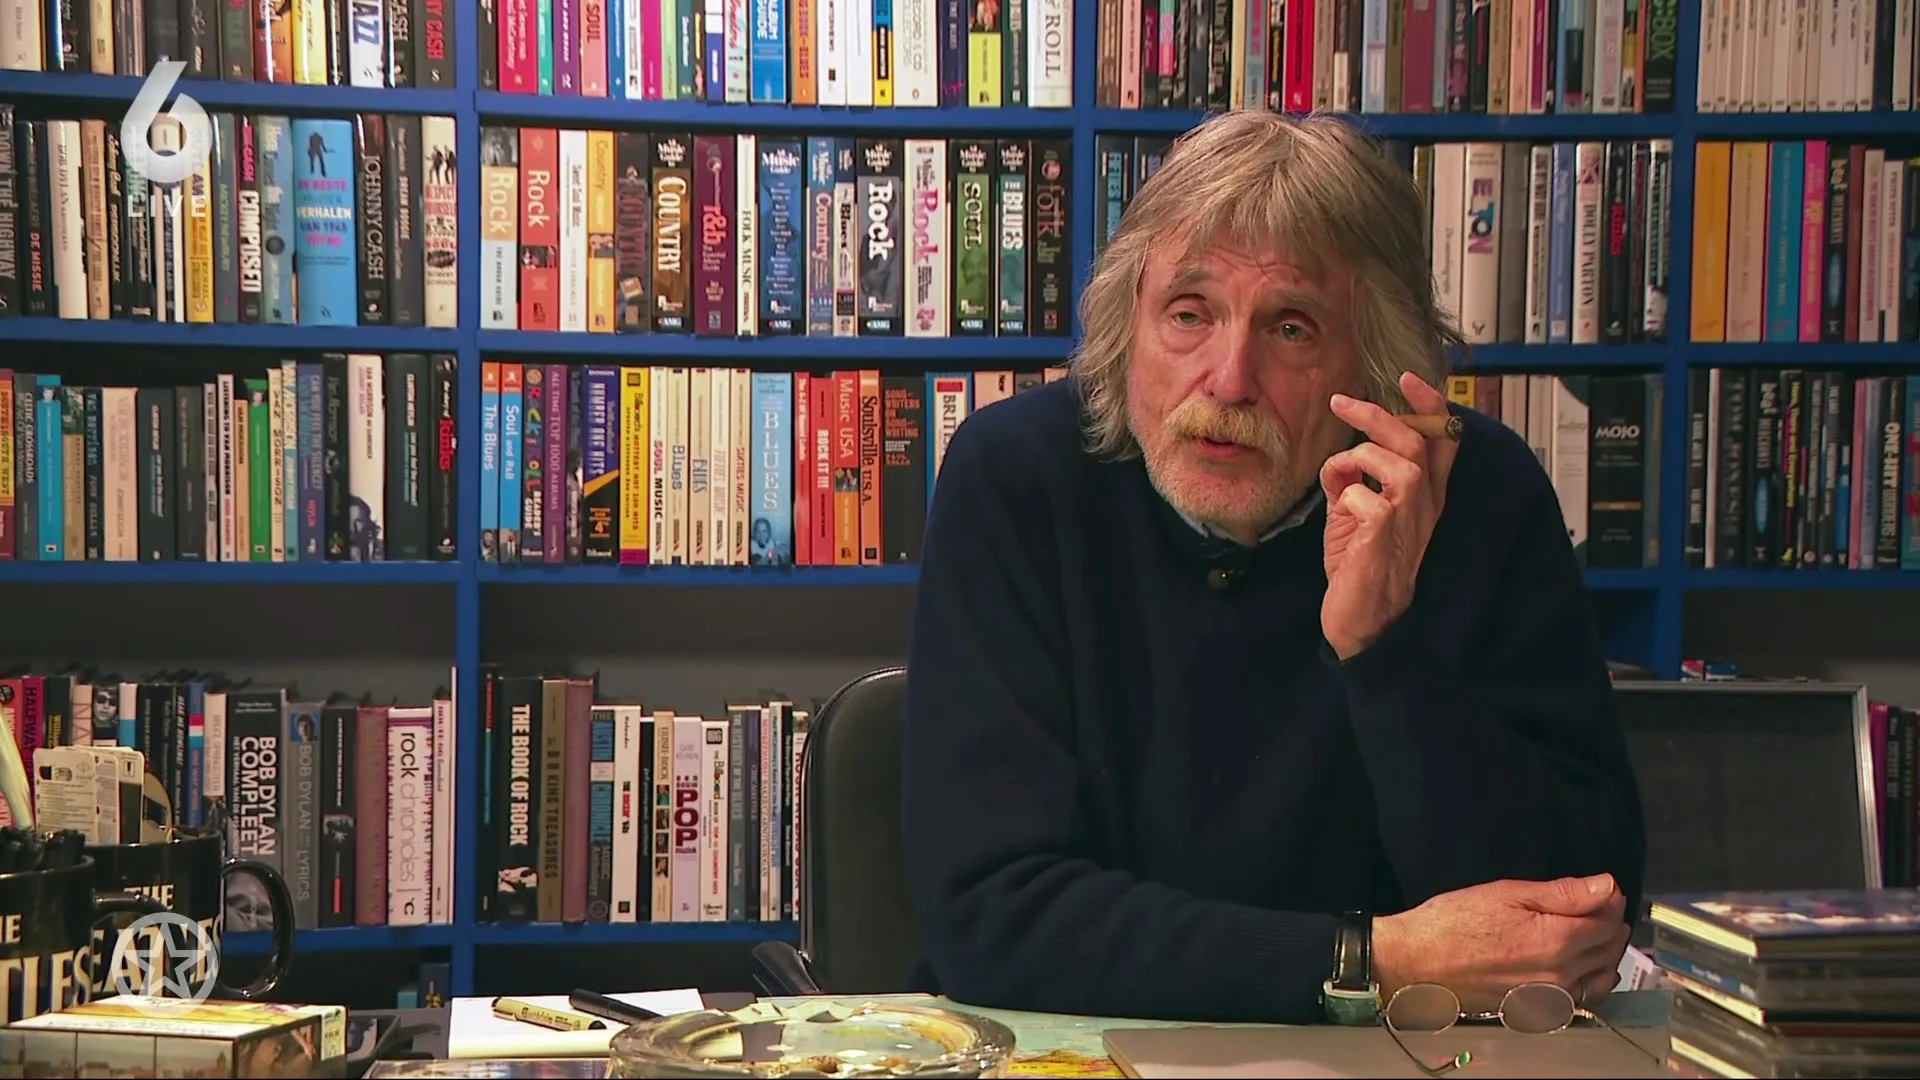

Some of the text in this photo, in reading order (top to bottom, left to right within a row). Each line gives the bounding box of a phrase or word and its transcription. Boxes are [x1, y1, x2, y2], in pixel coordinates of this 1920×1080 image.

[353, 0, 380, 45] AZZ
[425, 20, 444, 60] CASH
[586, 4, 601, 43] SOUL
[1045, 14, 1061, 78] ROLL
[595, 140, 608, 191] Country
[0, 179, 19, 209] THE
[297, 207, 352, 219] VERHALEN
[364, 155, 384, 280] JOHNNY CASH
[490, 172, 514, 234] Rock
[527, 170, 551, 228] Rock
[963, 181, 982, 250] SOUL
[1036, 183, 1065, 238] folk
[0, 212, 16, 280] HIGHWAY
[239, 190, 262, 292] COMPOSED
[657, 176, 687, 273] COUNTRY
[702, 205, 727, 245] r&b
[812, 192, 832, 262] Country
[840, 203, 850, 249] Blues
[868, 180, 894, 261] Rock
[913, 188, 939, 265] Rock
[1002, 191, 1023, 250] BLUES
[30, 232, 42, 292] DE MISSIE
[742, 210, 752, 289] FOLK MUSIC
[1581, 203, 1597, 306] DOLLY PARTON
[311, 375, 321, 392] CAN
[312, 394, 321, 411] YOU
[551, 372, 560, 387] ALL
[551, 390, 560, 412] TIME
[998, 374, 1006, 393] New
[1759, 382, 1777, 415] beat
[24, 392, 35, 484] CELTIC CROSSROADS
[223, 381, 234, 495] LISTENING TO VAN MORRISON
[312, 412, 321, 431] FEEL
[312, 433, 321, 449] THE
[484, 405, 497, 470] The Blues
[505, 405, 519, 480] Soul and R&B
[550, 416, 561, 440] TOP
[590, 383, 605, 475] NUMBER ONE HITS
[839, 378, 853, 458] Music USA
[1594, 426, 1639, 439] MOJO
[1788, 408, 1799, 433] There
[1789, 434, 1797, 452] and
[440, 420, 454, 470] kinks
[550, 444, 561, 471] 1000
[671, 445, 685, 490] Blues
[763, 411, 780, 509] BLUES
[817, 429, 829, 461] ROCK
[817, 462, 829, 473] IT
[861, 396, 877, 505] Soulsville U.S.A.
[1884, 421, 1900, 488] ONE-HIT
[654, 440, 664, 519] SOUL MUSIC
[692, 458, 708, 494] BLUES
[713, 449, 725, 516] FIFTIES MUSIC
[736, 447, 744, 513] SIXTIES MUSIC
[1786, 454, 1797, 508] Everywhere
[525, 498, 533, 529] GUIDE
[533, 490, 542, 537] READER'S
[23, 686, 37, 752] HALFWAY
[177, 718, 184, 728] ME
[232, 736, 240, 750] HET
[232, 752, 240, 785] VERHAAL
[547, 750, 559, 758] B
[732, 728, 743, 766] HISTORY
[232, 787, 240, 802] VAN
[241, 736, 258, 855] COMPLEET
[259, 736, 276, 855] BOB DYLAN
[510, 704, 530, 846] THE BOOK OF ROCK
[546, 775, 559, 803] KING
[713, 761, 724, 800] Billboard
[297, 745, 312, 901] BOB DYLAN LYRICS
[400, 731, 420, 882] rock chronicles
[675, 789, 699, 847] POP
[732, 791, 743, 820] BLUES
[545, 808, 558, 879] TREASURES
